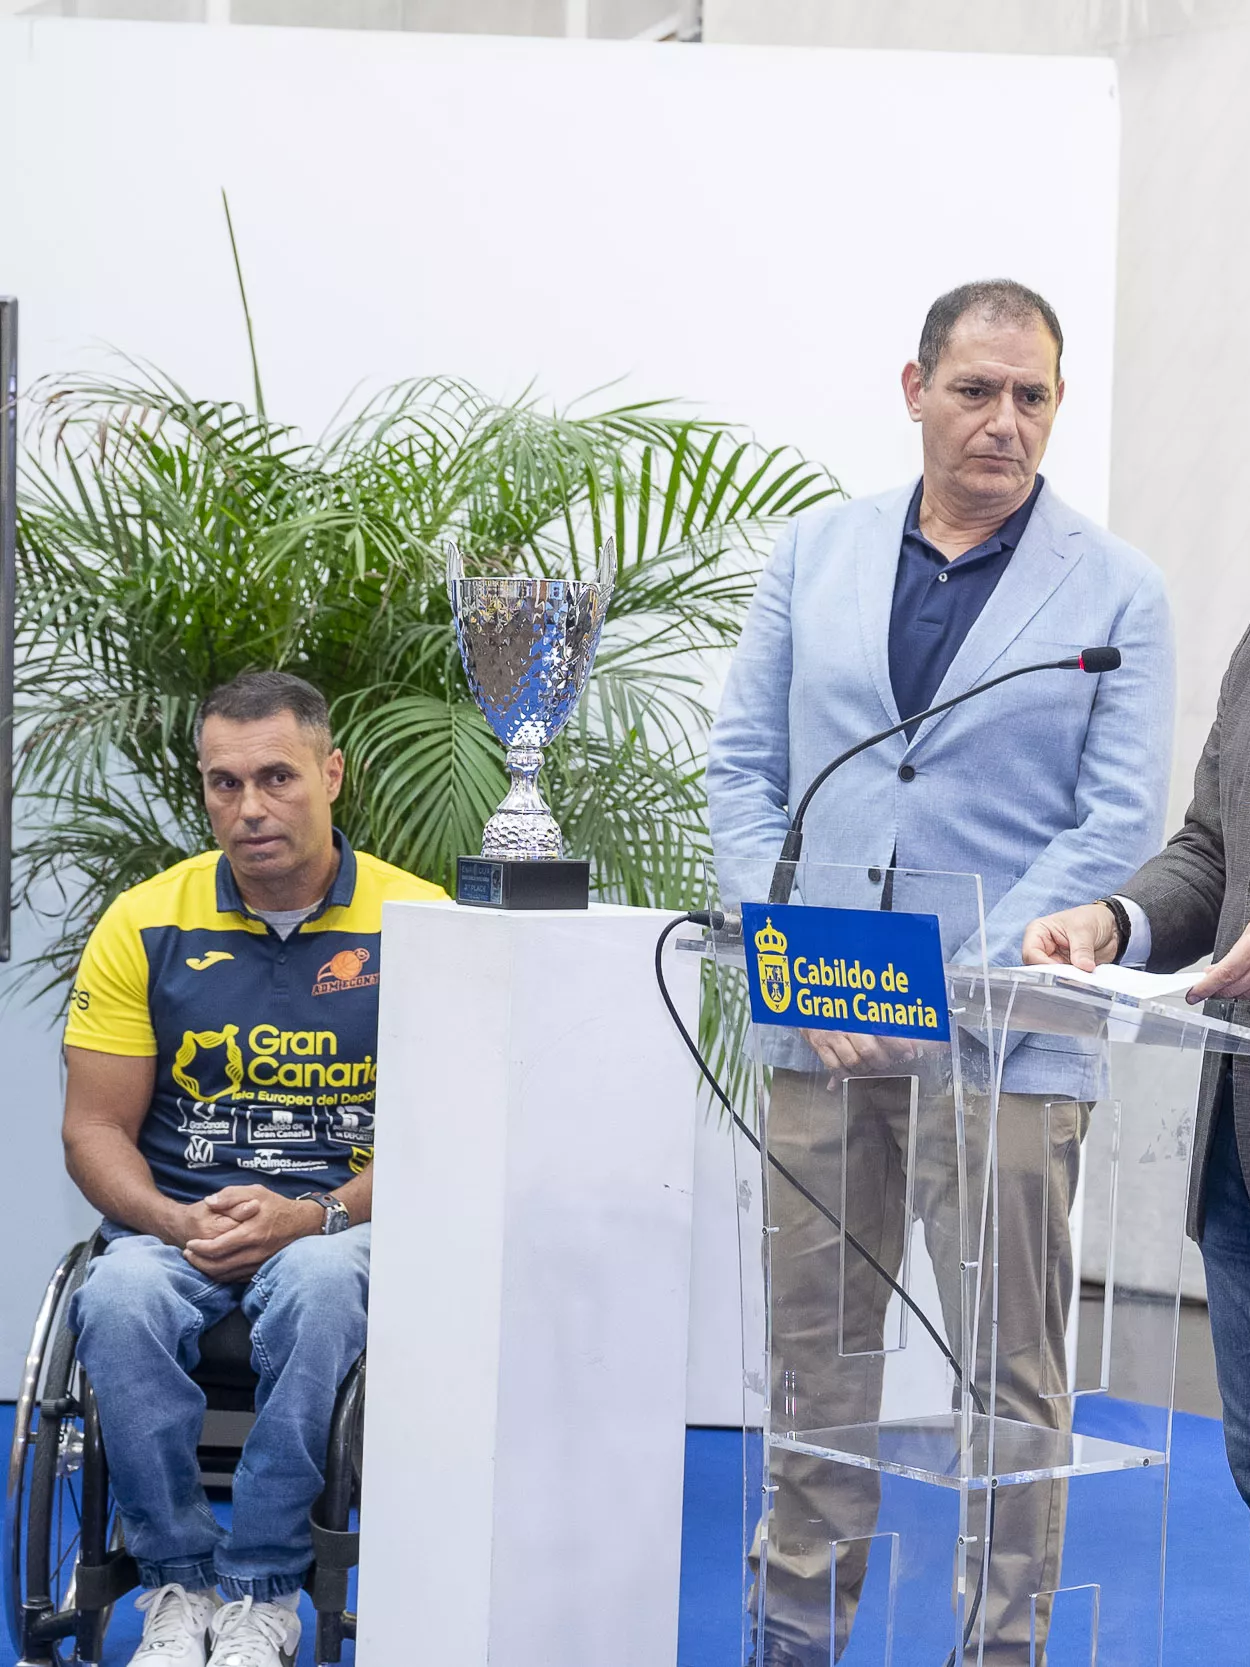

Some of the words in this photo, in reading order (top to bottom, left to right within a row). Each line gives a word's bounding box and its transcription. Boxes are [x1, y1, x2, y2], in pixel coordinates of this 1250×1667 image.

[794, 956, 876, 990] Cabildo
[880, 963, 909, 993] de
[796, 988, 848, 1020] Gran
[853, 993, 938, 1028] Canaria
[248, 1024, 337, 1055] Gran
[258, 1091, 313, 1106] Europea
[317, 1094, 337, 1105] del
[257, 1122, 290, 1131] Cabildo
[277, 1129, 310, 1139] Canaria
